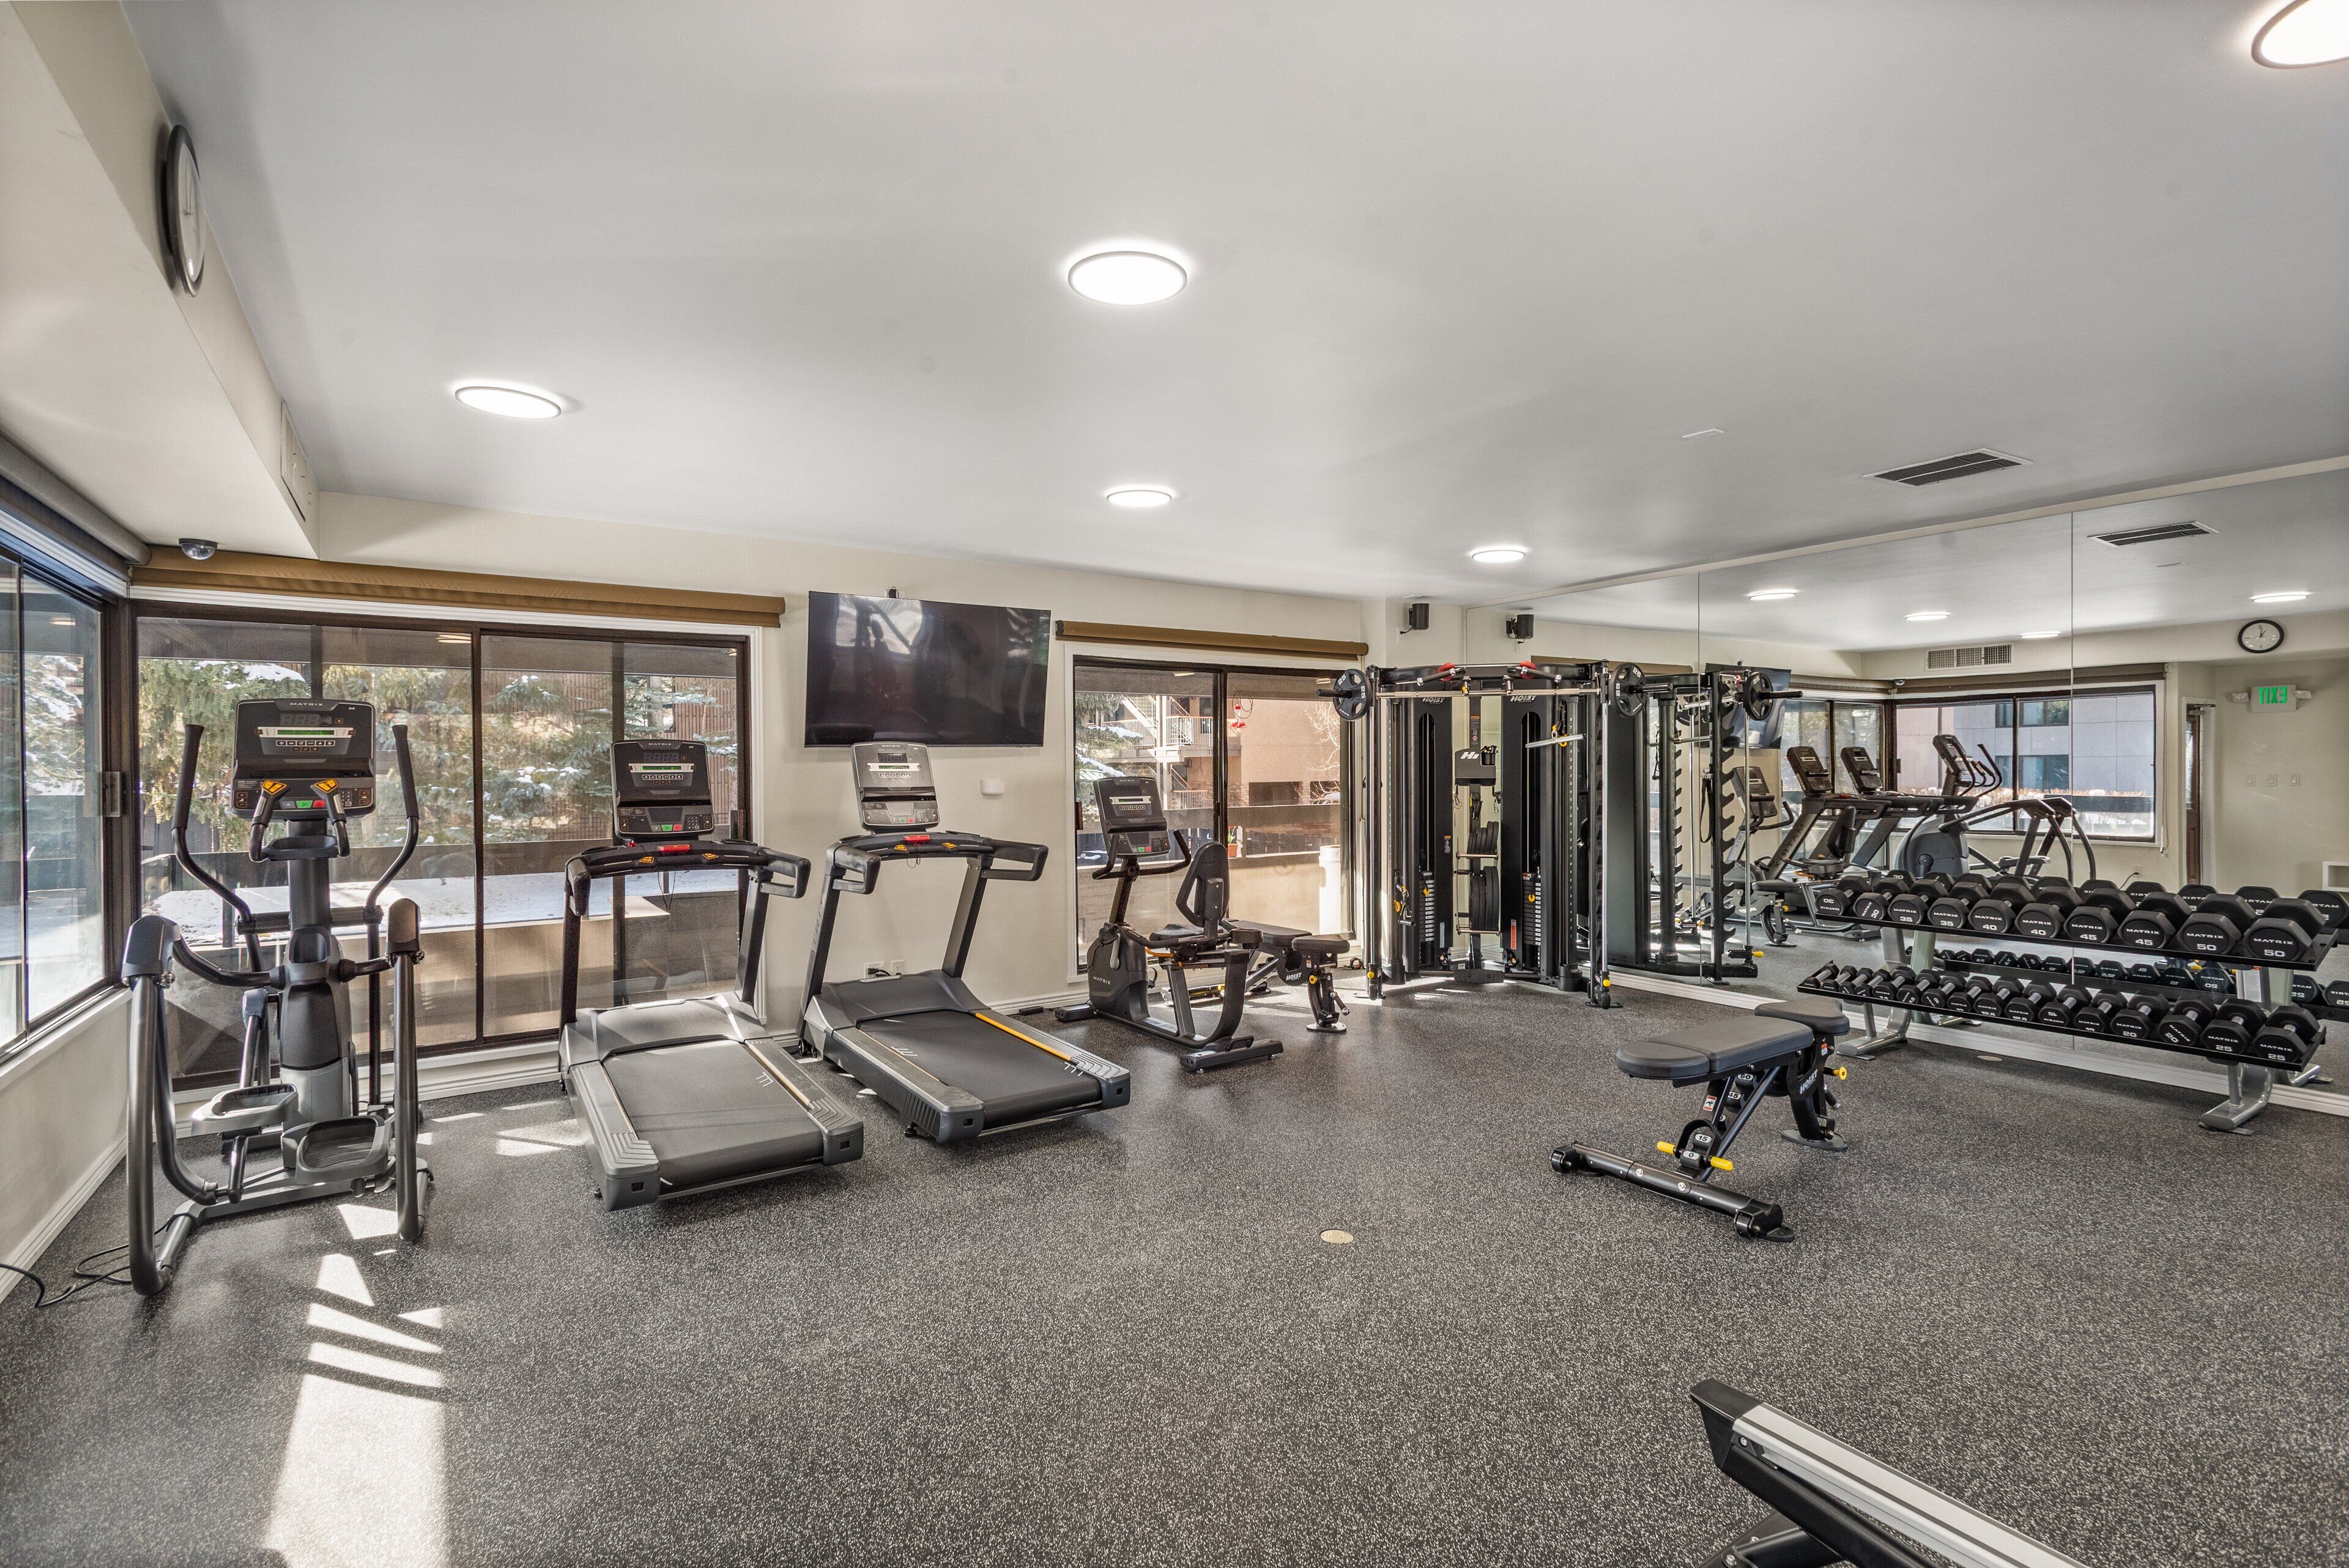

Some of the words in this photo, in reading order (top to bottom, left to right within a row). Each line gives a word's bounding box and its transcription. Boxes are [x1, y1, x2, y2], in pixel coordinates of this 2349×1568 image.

[1338, 674, 1347, 685] 25
[1361, 685, 1366, 699] 25
[1861, 902, 1872, 916] MATRIX
[1871, 909, 1880, 918] 30
[2264, 949, 2285, 957] 50
[1093, 976, 1111, 985] MATRIX
[1286, 972, 1302, 981] HOIST
[2165, 1032, 2178, 1043] 20
[2169, 1025, 2191, 1042] MATRIX
[1800, 1069, 1818, 1094] HOIST
